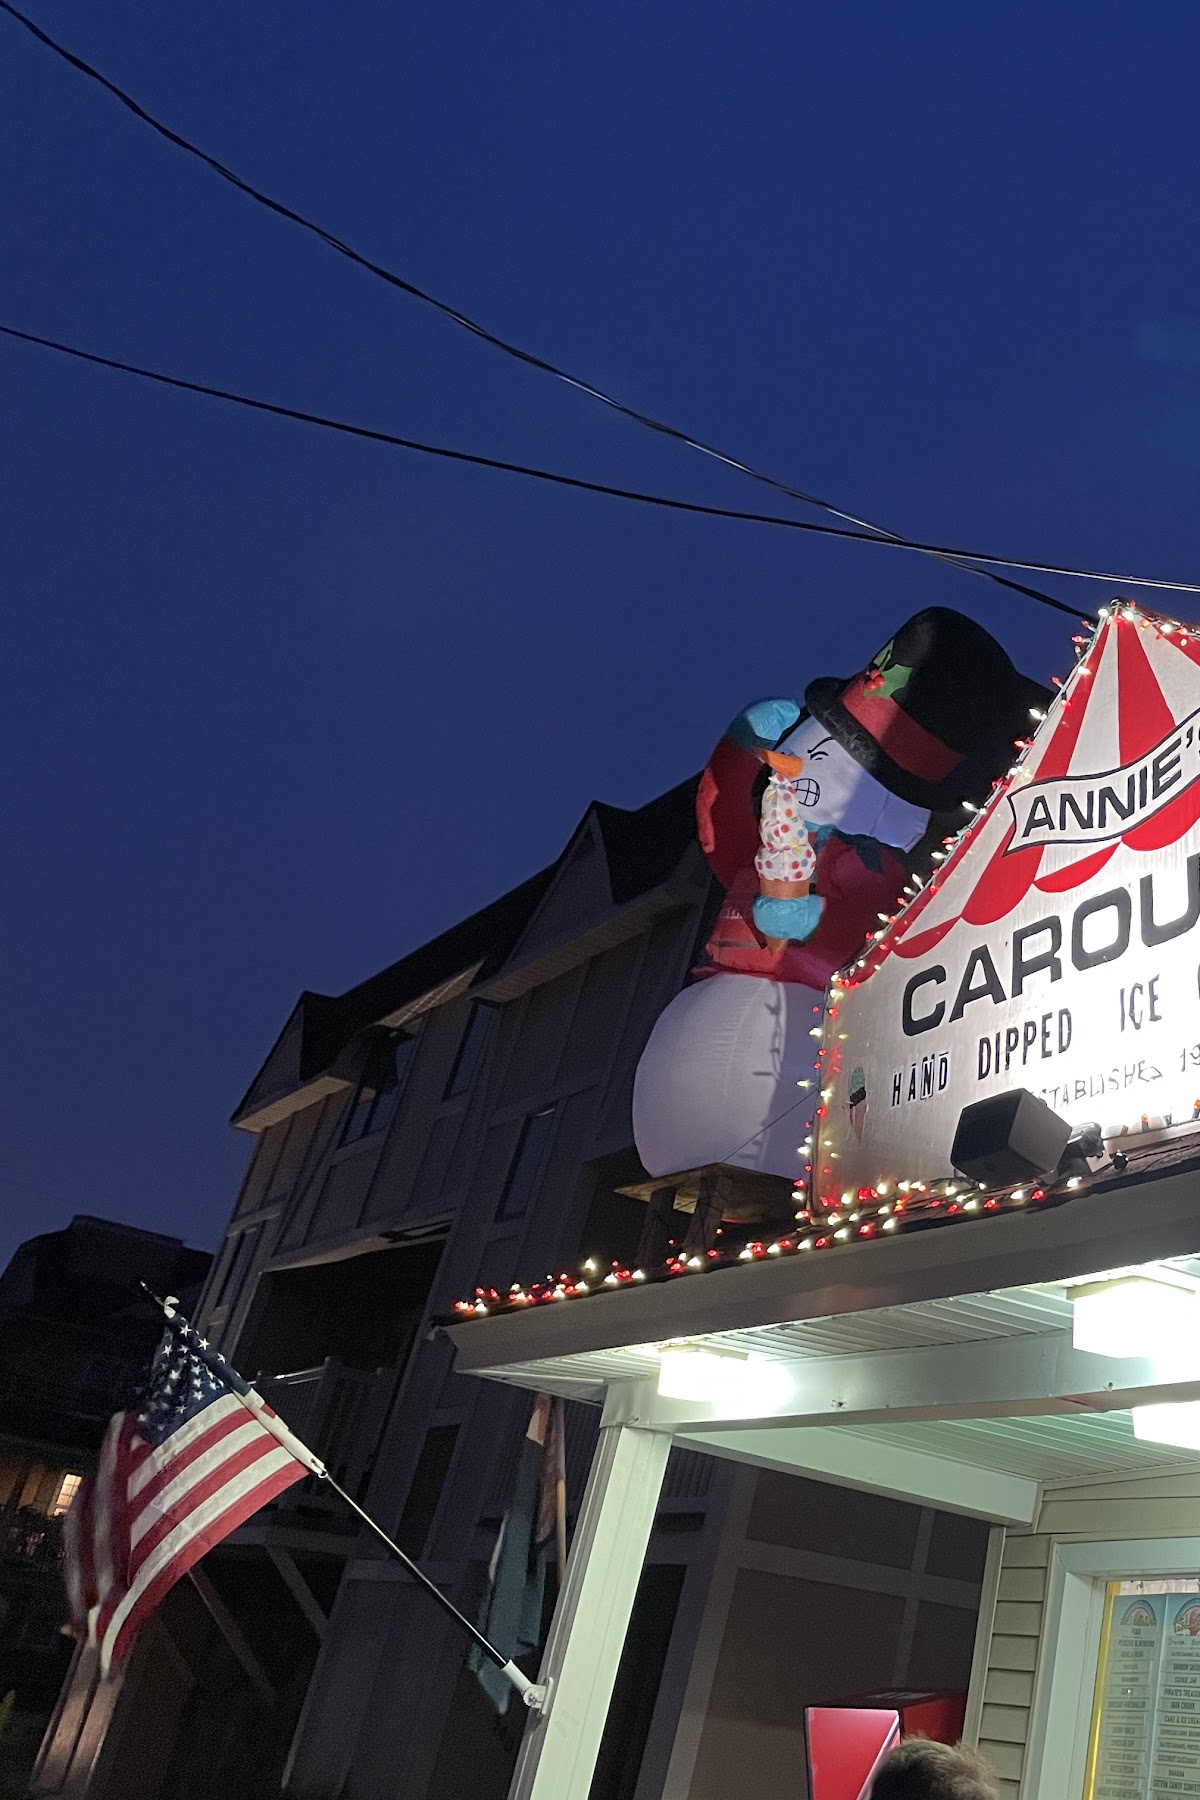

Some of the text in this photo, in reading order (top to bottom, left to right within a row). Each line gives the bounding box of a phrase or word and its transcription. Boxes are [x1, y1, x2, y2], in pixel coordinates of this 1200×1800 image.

[892, 1051, 949, 1107] HAND
[977, 1008, 1073, 1081] DIPPED
[1119, 974, 1162, 1033] ICE
